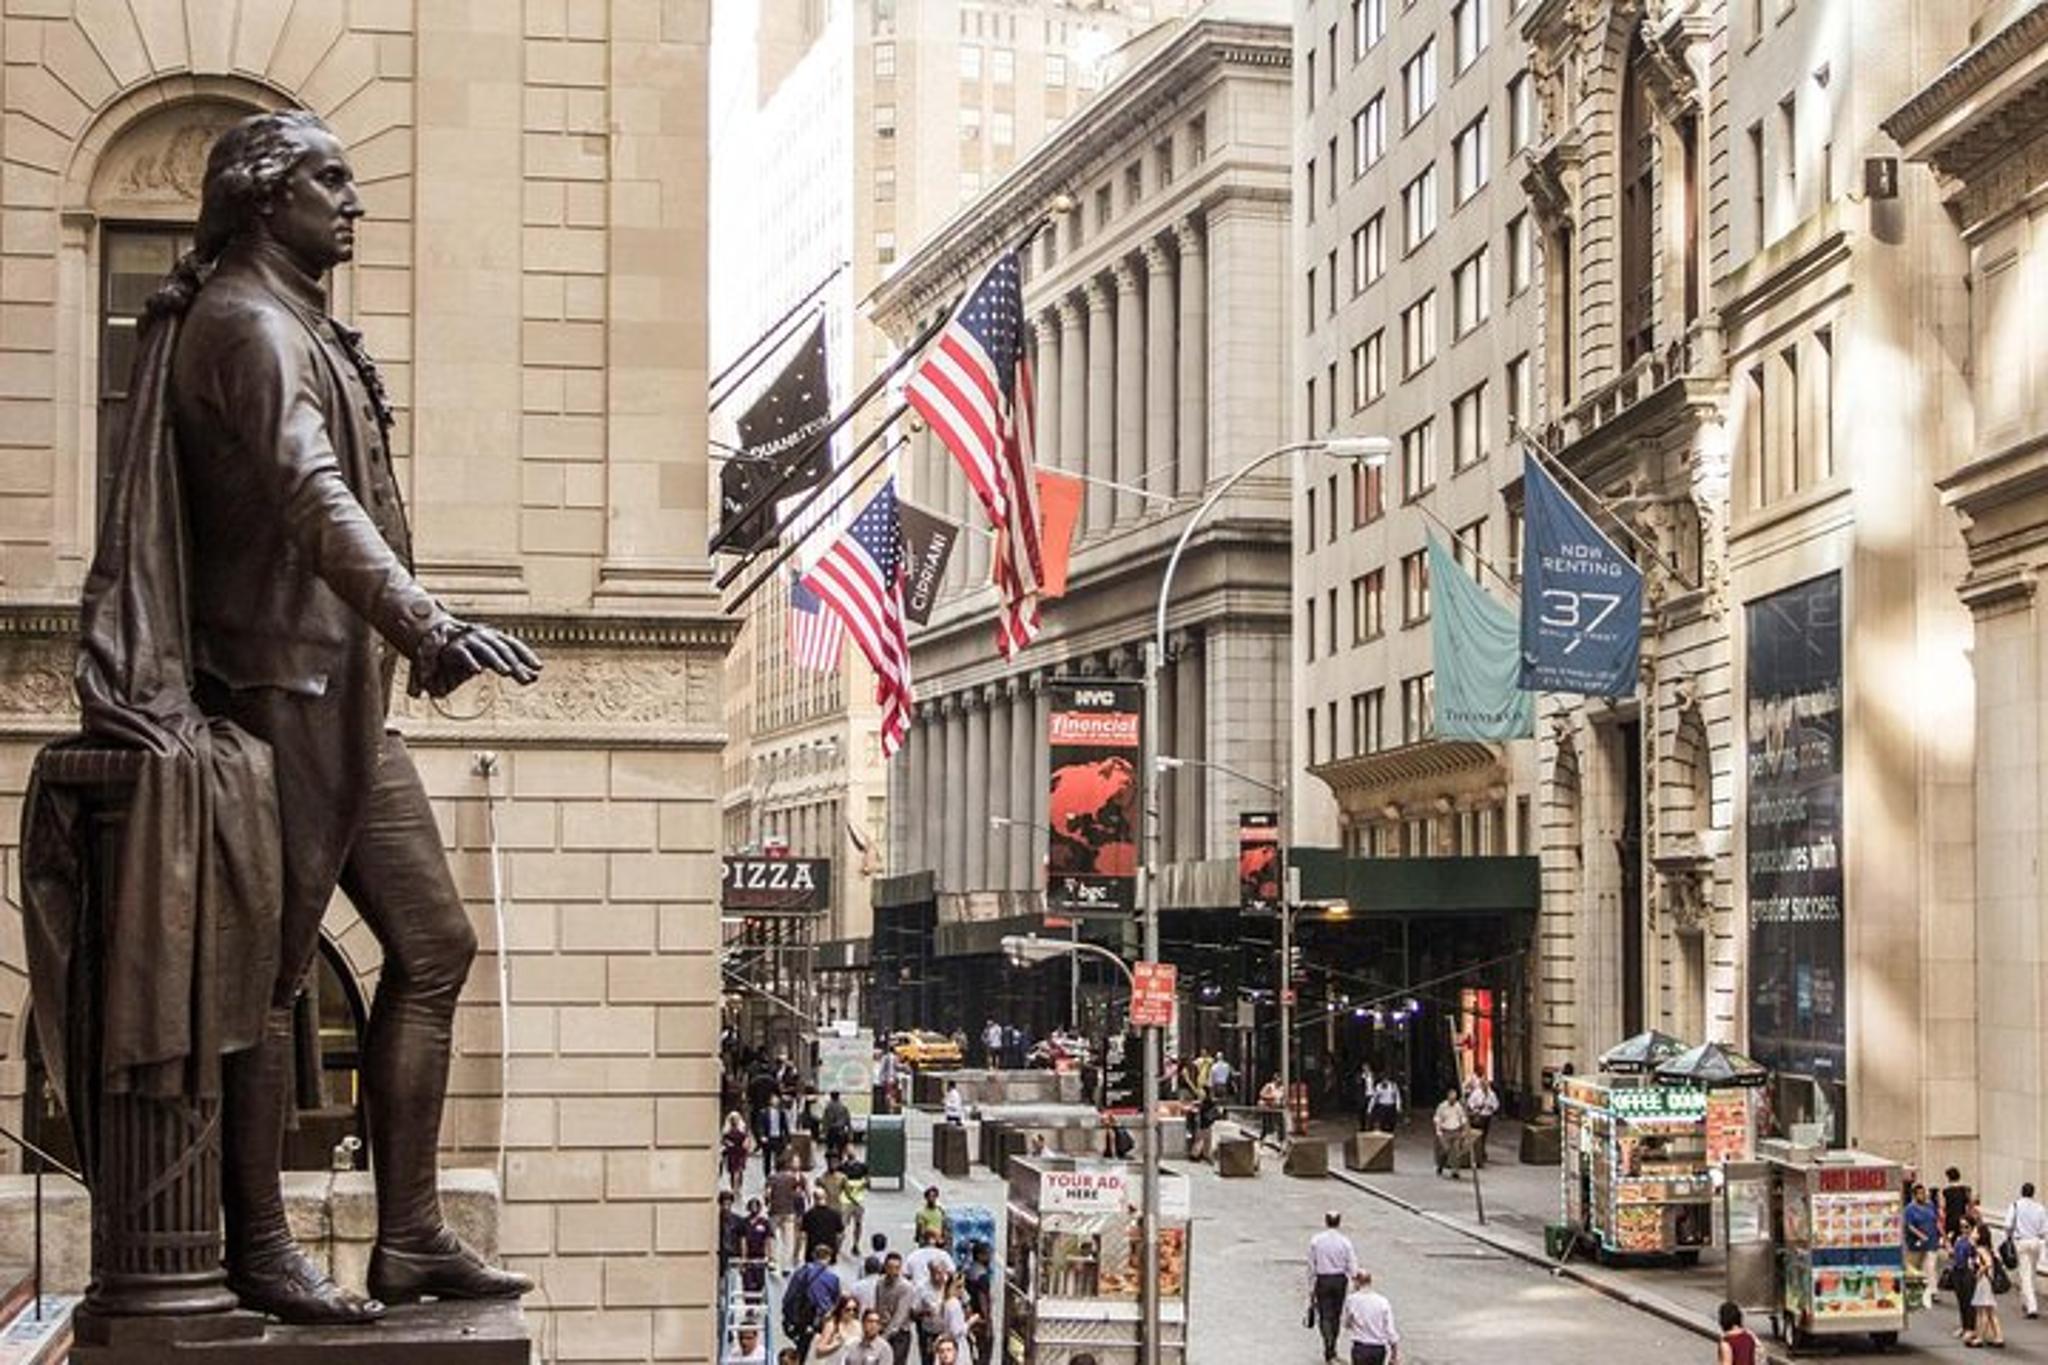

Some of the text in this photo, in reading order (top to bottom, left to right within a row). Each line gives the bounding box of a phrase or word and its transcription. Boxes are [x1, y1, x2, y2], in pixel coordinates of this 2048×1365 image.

[1561, 544, 1603, 559] NOW
[912, 531, 947, 611] CIPRIANI
[1543, 556, 1622, 577] RENTING
[1540, 590, 1622, 654] 37
[1074, 689, 1115, 706] NYC
[1811, 836, 1837, 870] with
[1047, 1174, 1120, 1189] YOUR AD
[1066, 1188, 1098, 1199] HERE
